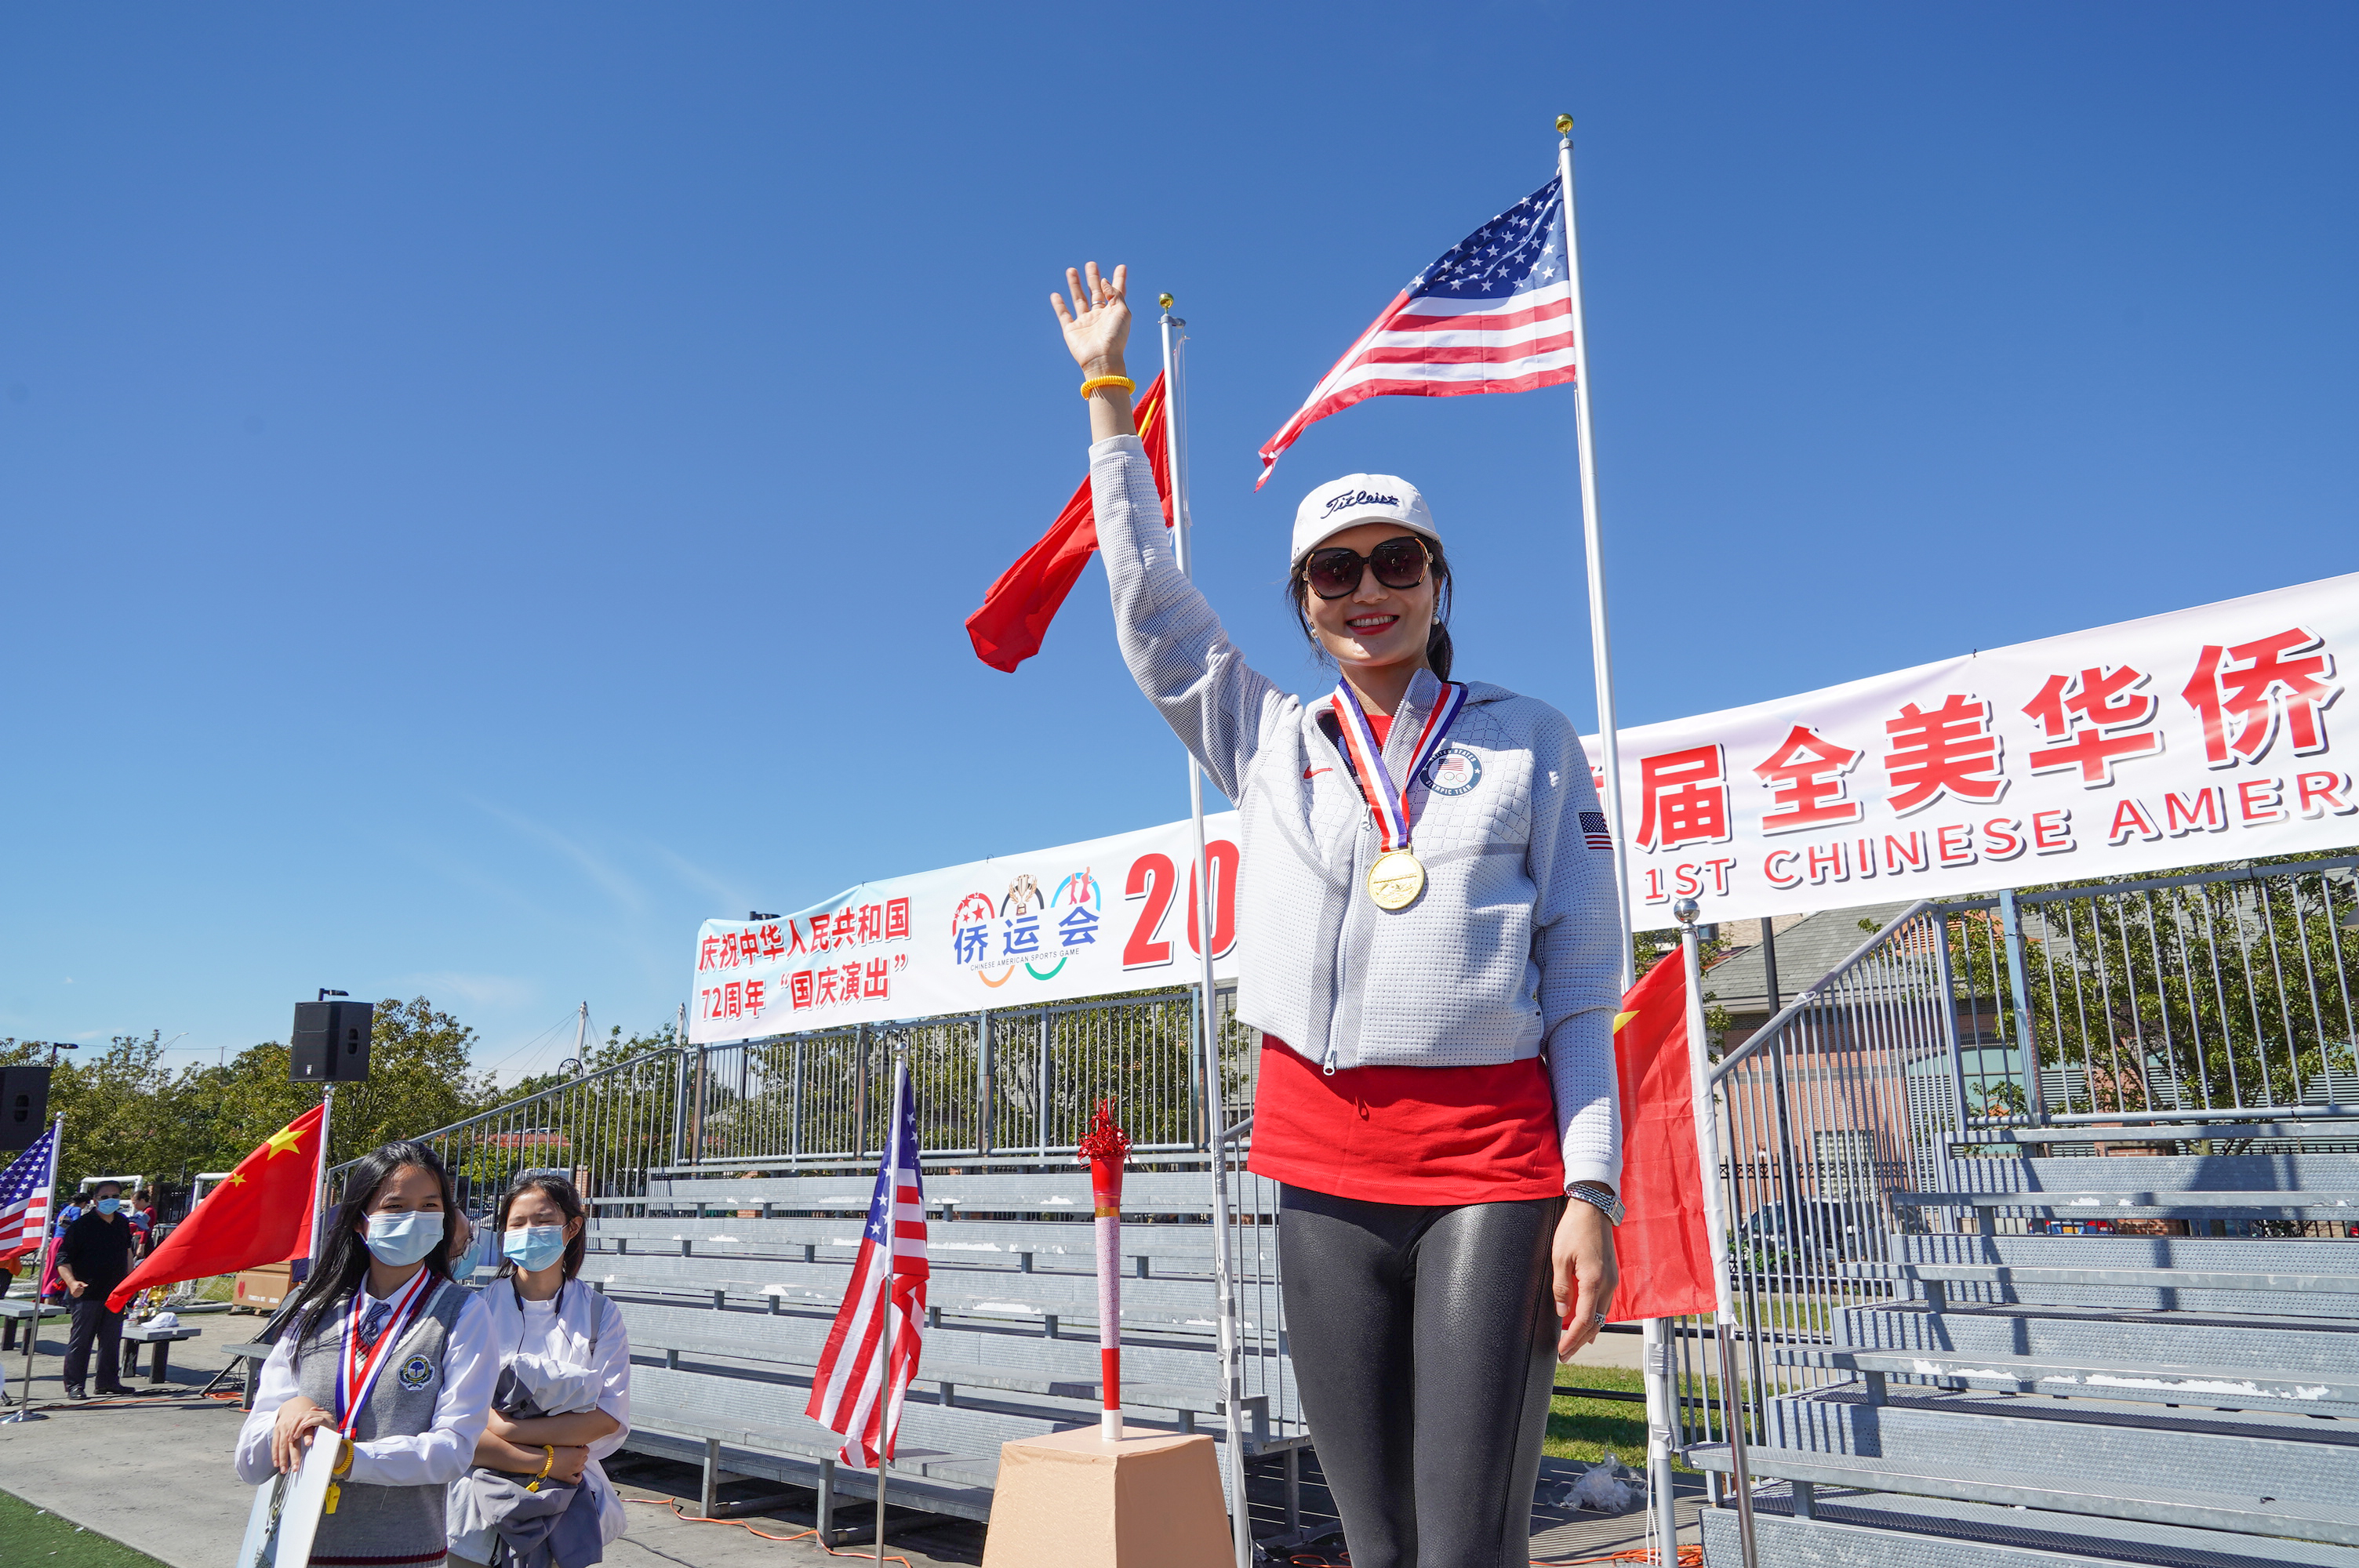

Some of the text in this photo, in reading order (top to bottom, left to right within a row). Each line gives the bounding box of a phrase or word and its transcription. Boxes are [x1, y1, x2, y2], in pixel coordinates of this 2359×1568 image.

[1320, 489, 1400, 519] Titleist
[1454, 749, 1477, 762] STATES
[1590, 626, 2334, 850] 届全美华侨
[1425, 780, 1473, 795] OLYMPIC TEAM
[1645, 771, 2346, 901] 1ST CHINESE AMER
[699, 897, 910, 972] 庆祝中华人民共和国
[954, 906, 1100, 965] 侨运会
[970, 948, 1080, 971] CHINESE AMERICAN SPORTS GAME
[701, 979, 765, 1019] 72周年
